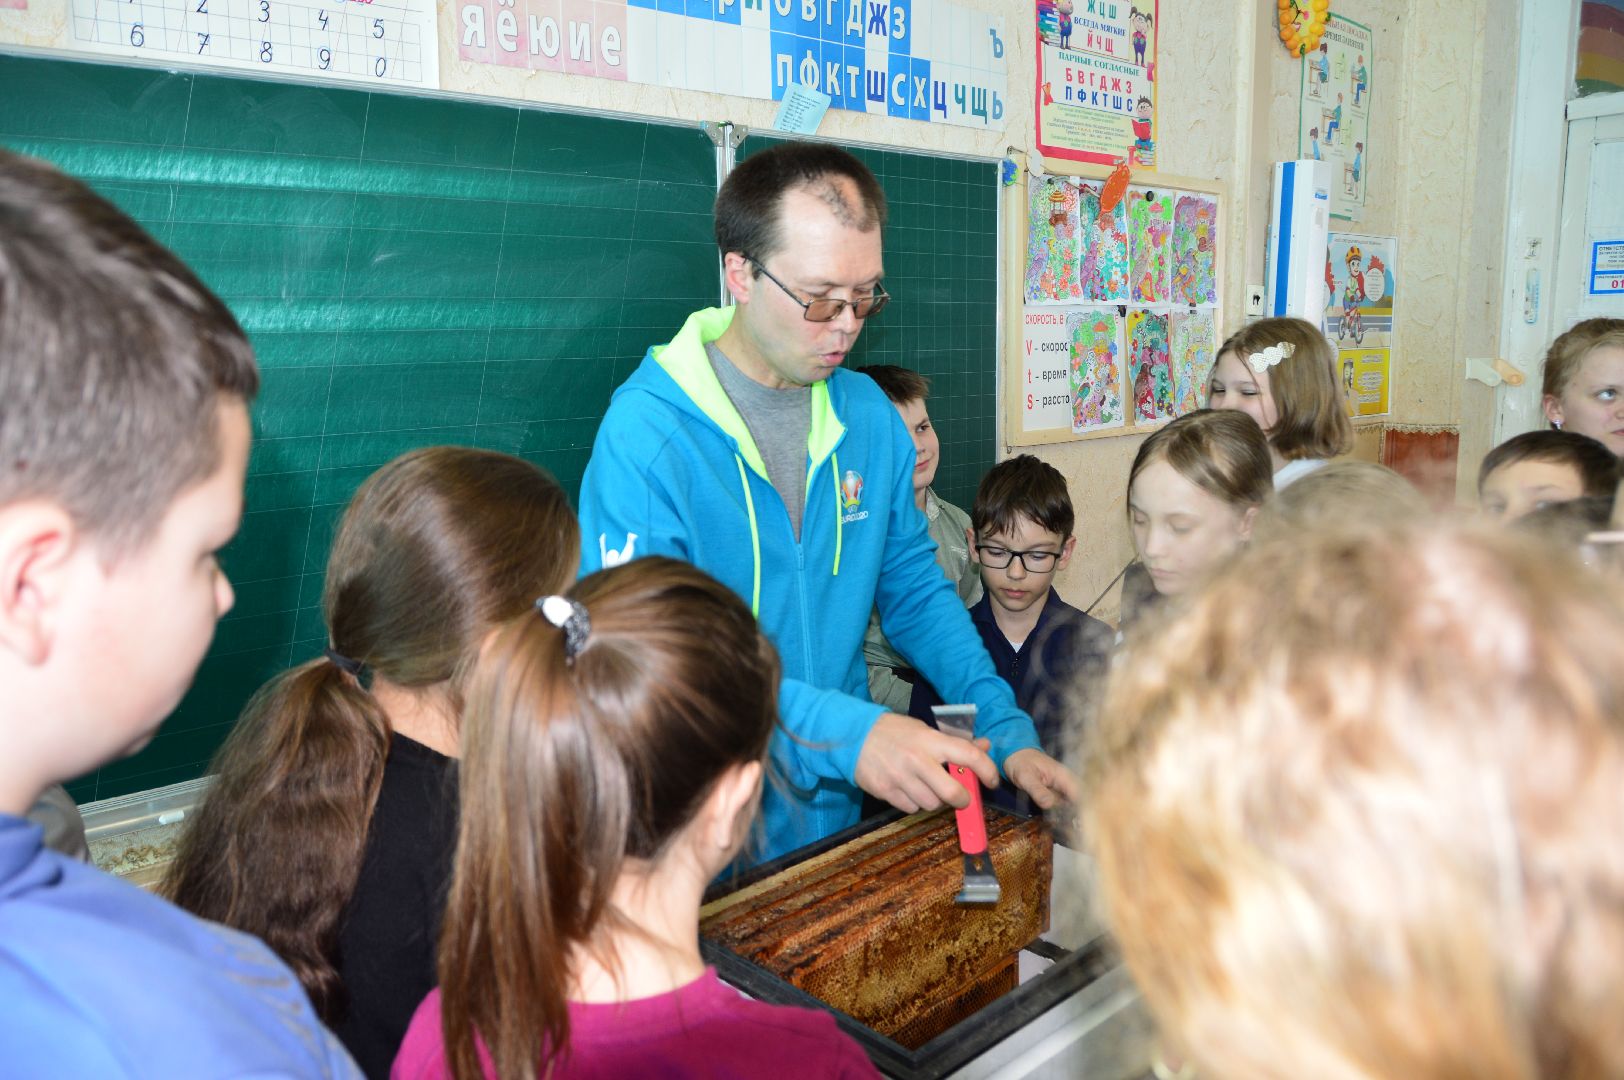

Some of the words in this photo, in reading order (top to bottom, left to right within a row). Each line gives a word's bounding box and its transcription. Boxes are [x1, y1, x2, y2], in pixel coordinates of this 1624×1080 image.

[196, 0, 209, 14] 2
[258, 1, 270, 23] 3
[318, 10, 329, 31] 4
[373, 18, 385, 39] 5
[1074, 17, 1098, 29] ВСЕГДА
[1100, 24, 1126, 36] МЯГКИЕ
[130, 24, 145, 47] 6
[197, 33, 210, 55] 7
[260, 41, 273, 63] 8
[319, 48, 331, 70] 9
[375, 57, 387, 77] 0
[1105, 38, 1113, 55] Щ
[1058, 51, 1092, 66] ПАРНЫЕ
[1094, 60, 1140, 76] СОГЛАСНЫЕ
[1025, 340, 1032, 355] V
[1042, 369, 1067, 382] время
[1042, 394, 1070, 409] рассто
